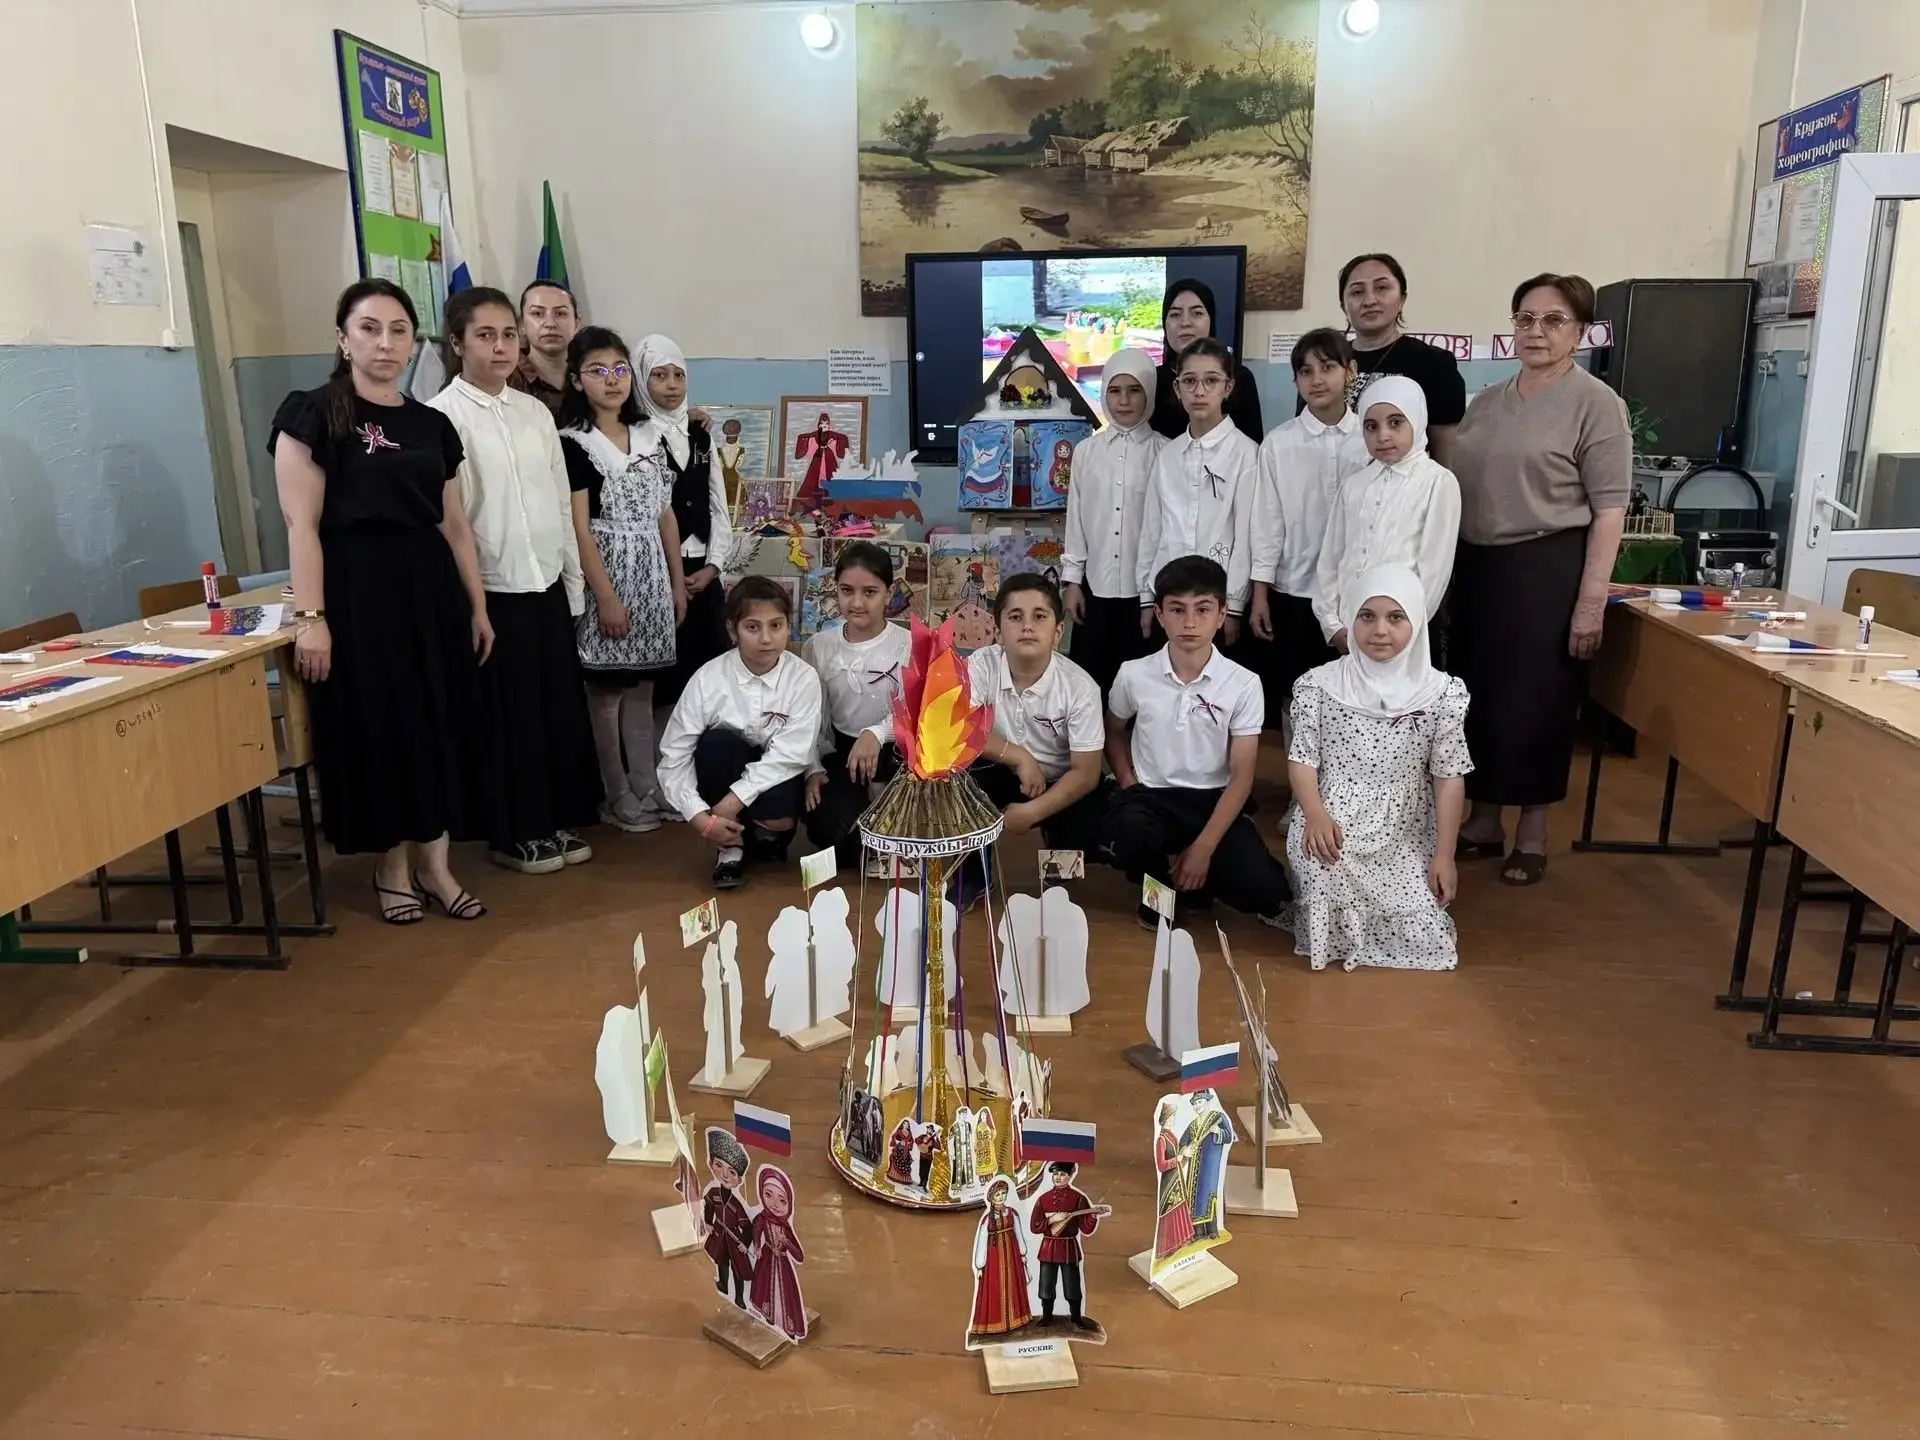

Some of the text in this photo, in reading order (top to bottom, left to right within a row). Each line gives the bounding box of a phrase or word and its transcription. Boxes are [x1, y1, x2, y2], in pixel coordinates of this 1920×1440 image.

[1794, 112, 1838, 139] Кружок
[1777, 137, 1850, 170] хореографии
[895, 840, 961, 858] дружбы
[1018, 1344, 1054, 1354] РУССКИЕ
